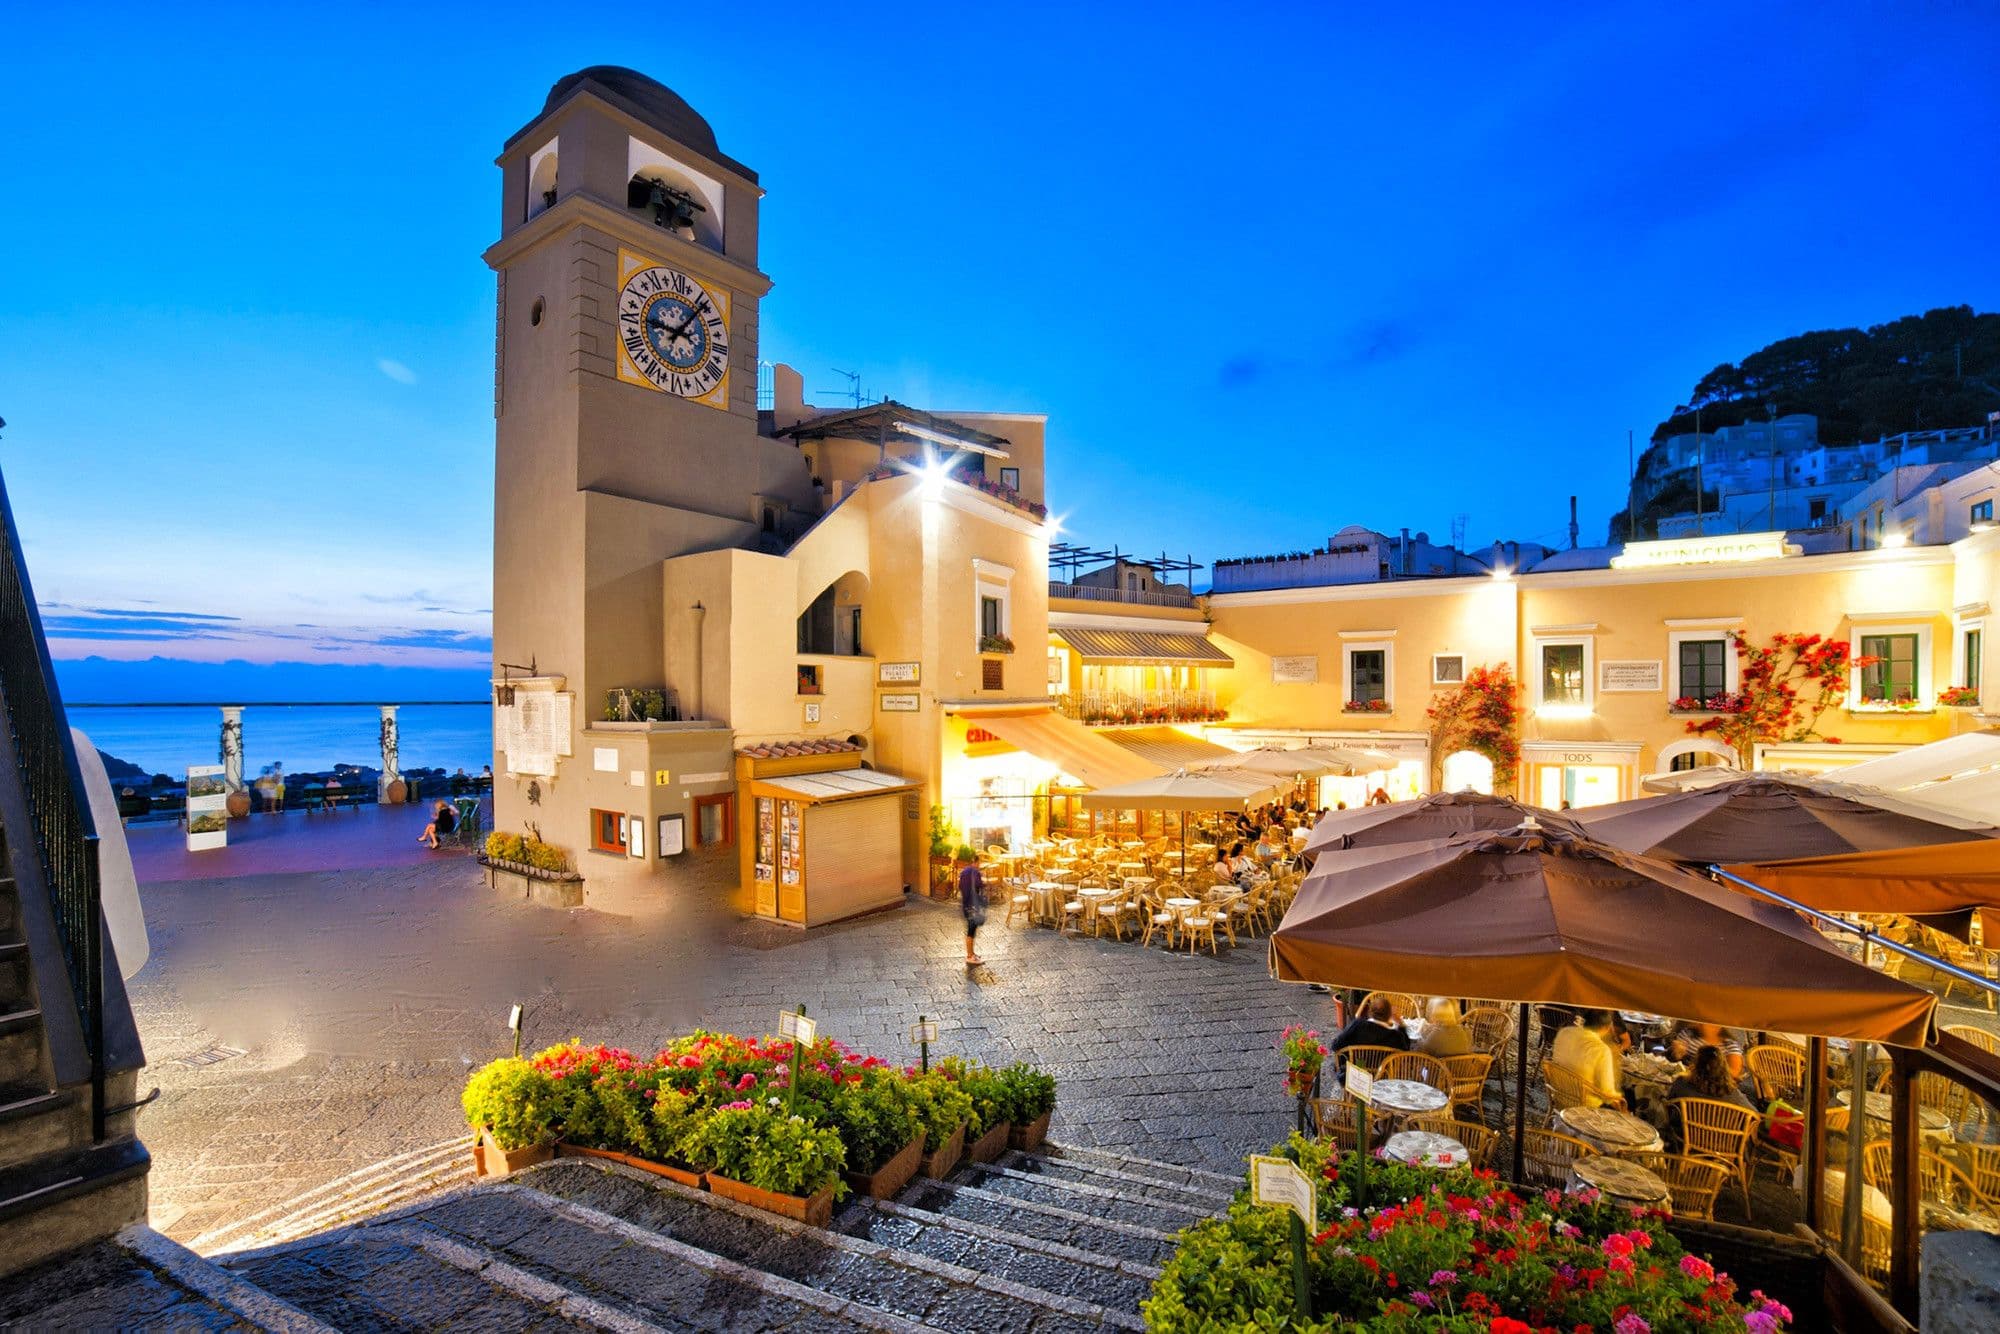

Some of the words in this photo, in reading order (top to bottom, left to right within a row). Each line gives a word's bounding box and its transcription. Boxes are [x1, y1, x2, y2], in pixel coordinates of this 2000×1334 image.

[645, 270, 662, 291] XI
[670, 271, 686, 295] XII
[627, 282, 647, 303] X
[708, 318, 723, 327] II
[712, 342, 728, 356] III
[670, 373, 685, 395] VI
[693, 376, 707, 393] V
